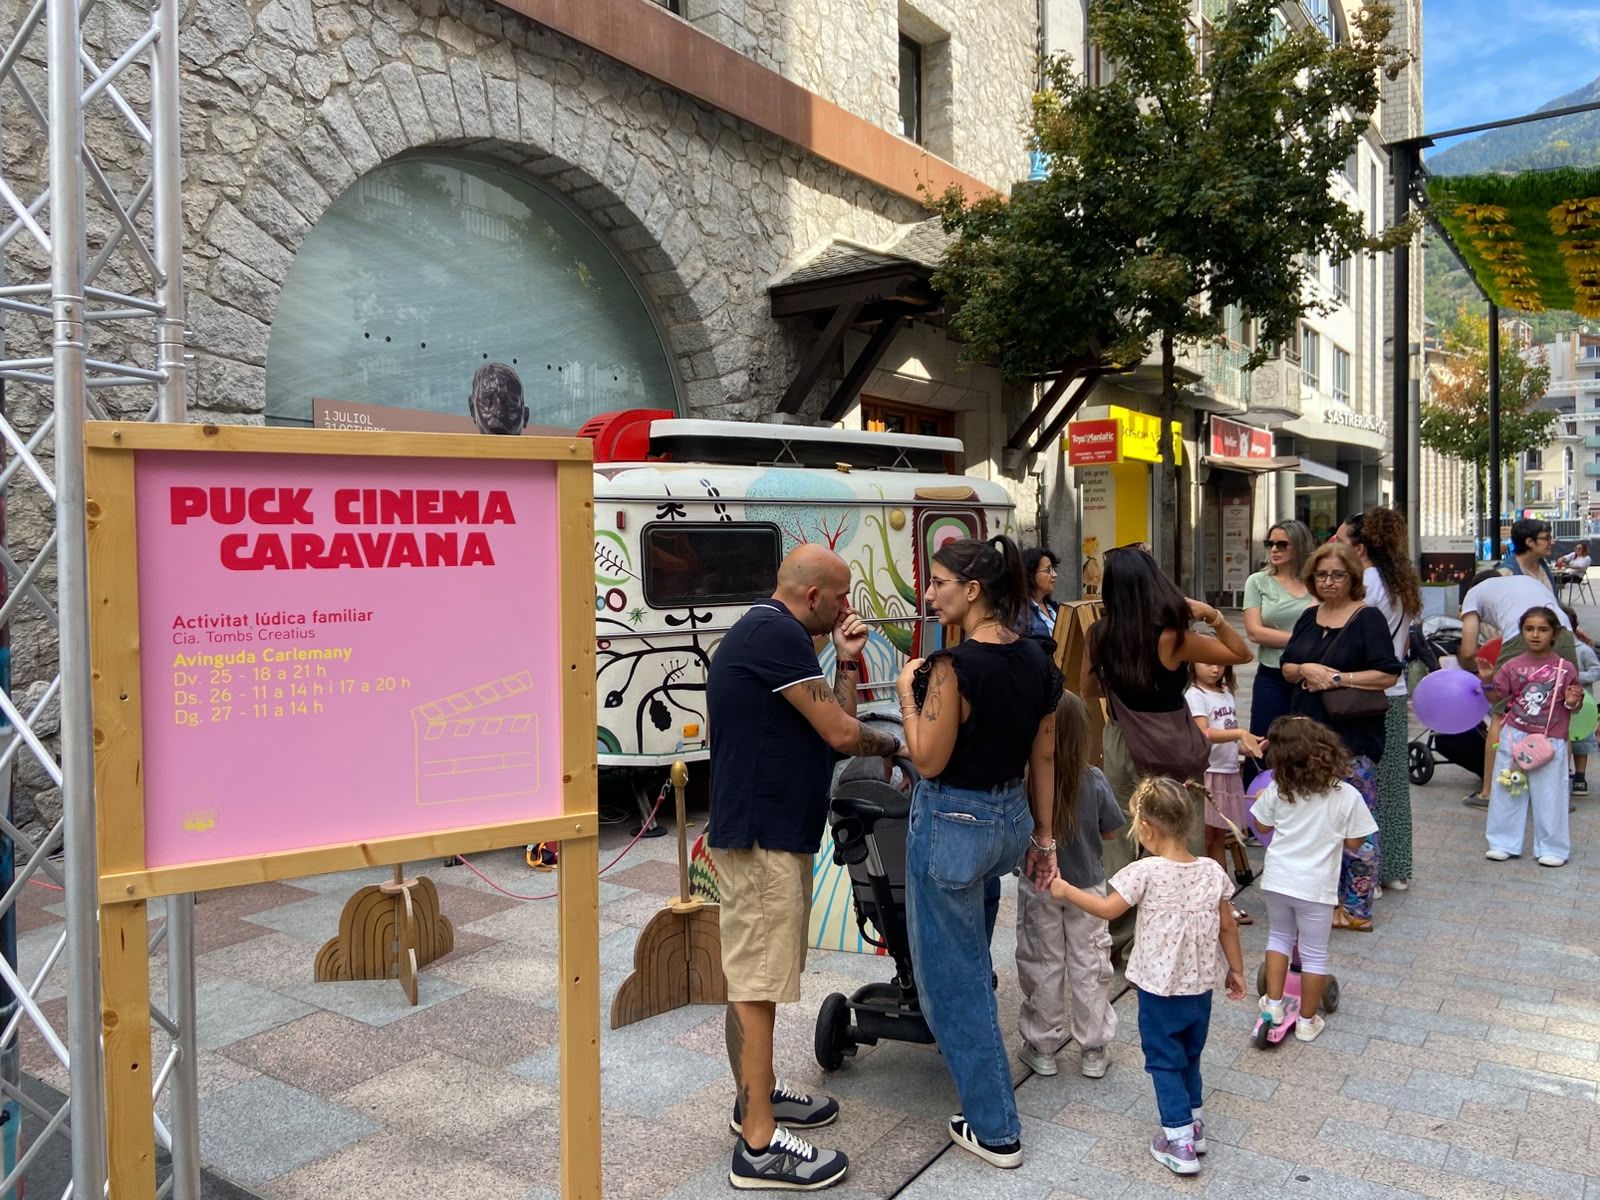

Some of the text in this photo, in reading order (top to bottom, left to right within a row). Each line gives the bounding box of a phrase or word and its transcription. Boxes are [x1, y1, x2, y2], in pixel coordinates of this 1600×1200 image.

[170, 487, 516, 525] PUCK CINEMA
[220, 531, 496, 571] CARAVANA
[172, 608, 374, 630] Activitat lúdica familiar
[172, 627, 316, 645] Cia. Tombs Creatius
[174, 647, 353, 669] Avinguda Carlemany
[174, 671, 202, 687] Dv.
[209, 668, 232, 684] 25
[252, 666, 271, 681] 18
[277, 669, 287, 681] a
[293, 664, 310, 679] 21
[317, 663, 327, 678] h
[174, 690, 202, 706] Ds.
[209, 688, 232, 704] 26
[252, 685, 267, 700] 11
[274, 687, 284, 699] a
[289, 682, 307, 697] 14
[313, 681, 324, 696] h
[329, 680, 334, 695] i
[339, 679, 355, 695] 17
[361, 681, 370, 693] a
[375, 676, 396, 691] 20
[401, 675, 411, 689] h
[175, 709, 204, 728] Dg.
[211, 705, 233, 722] 27
[253, 702, 268, 719] 11
[274, 705, 284, 717] a
[289, 700, 308, 716] 14
[313, 700, 324, 713] h
